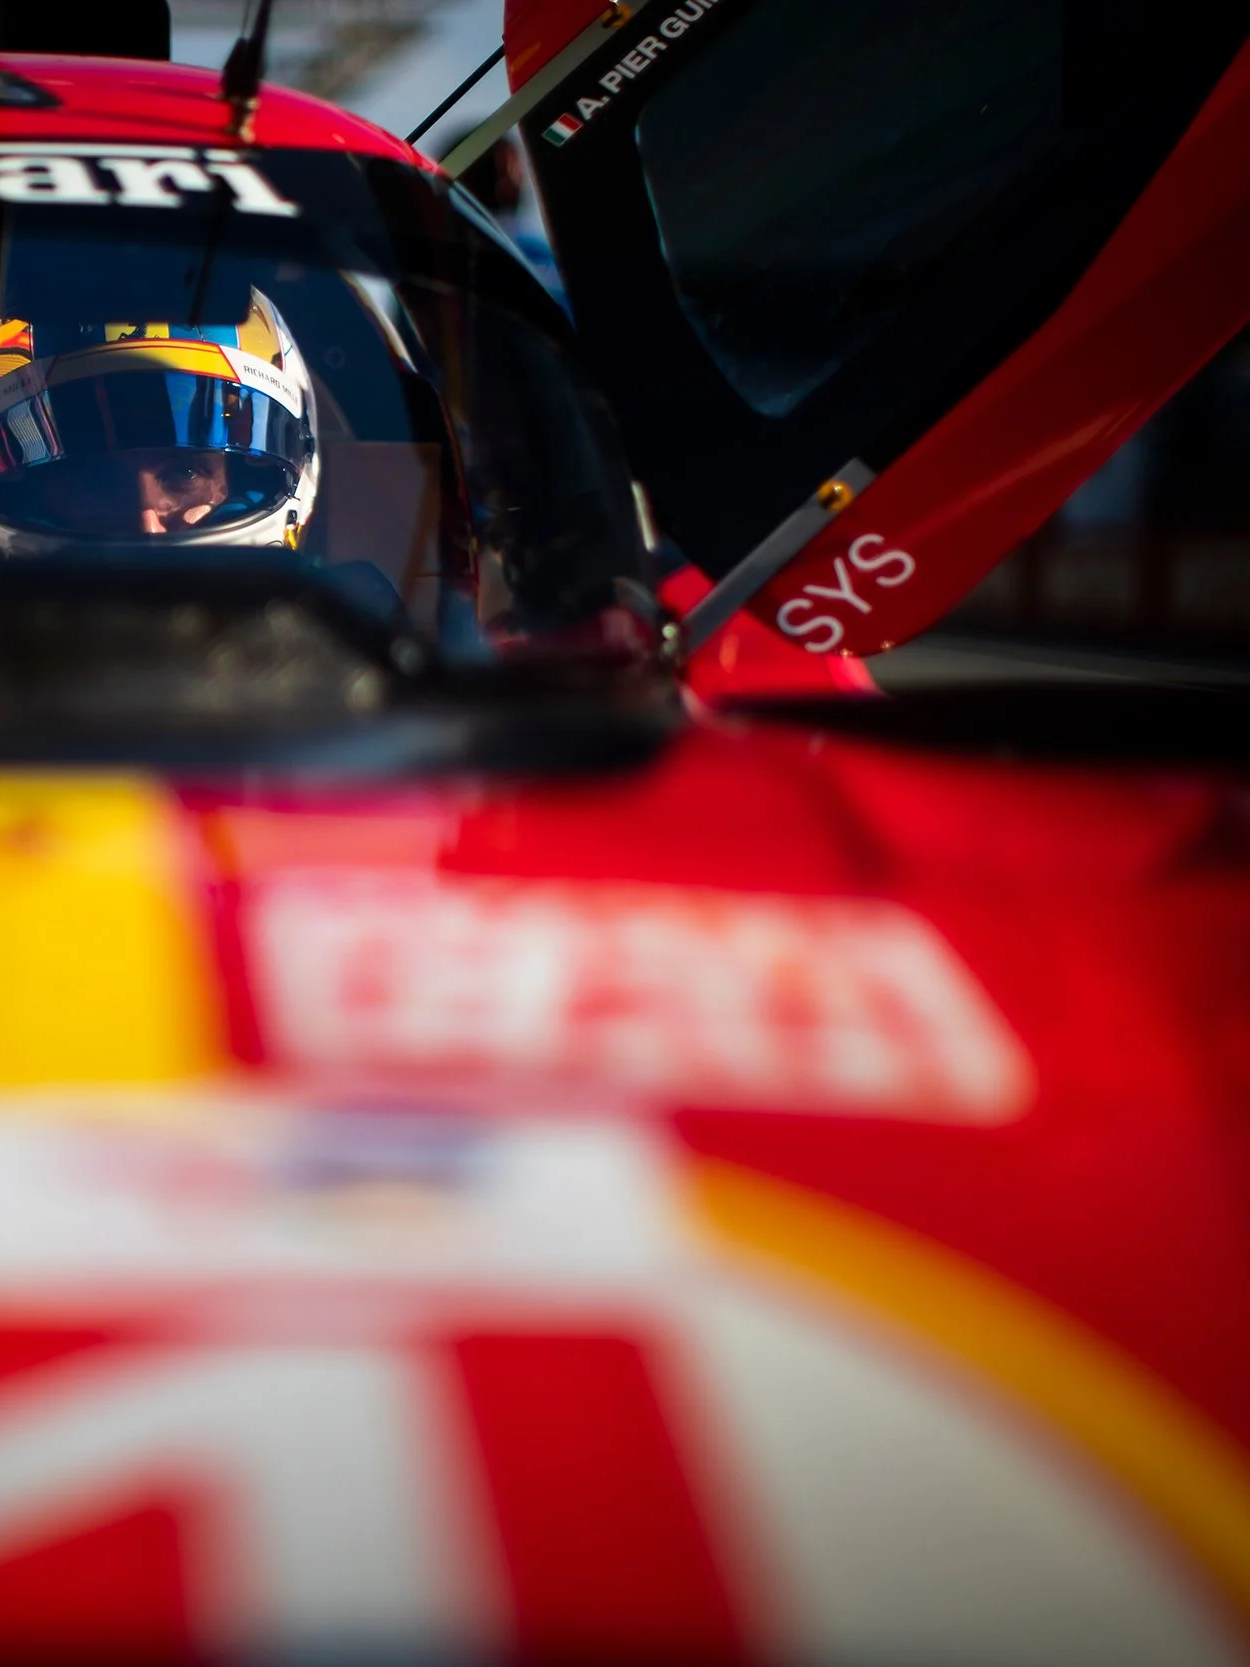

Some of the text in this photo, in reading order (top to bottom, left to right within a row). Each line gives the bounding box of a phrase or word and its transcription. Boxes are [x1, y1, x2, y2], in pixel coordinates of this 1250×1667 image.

[575, 0, 717, 121] A. PIER GUI
[243, 364, 281, 390] RICHARD
[776, 533, 916, 653] SYS
